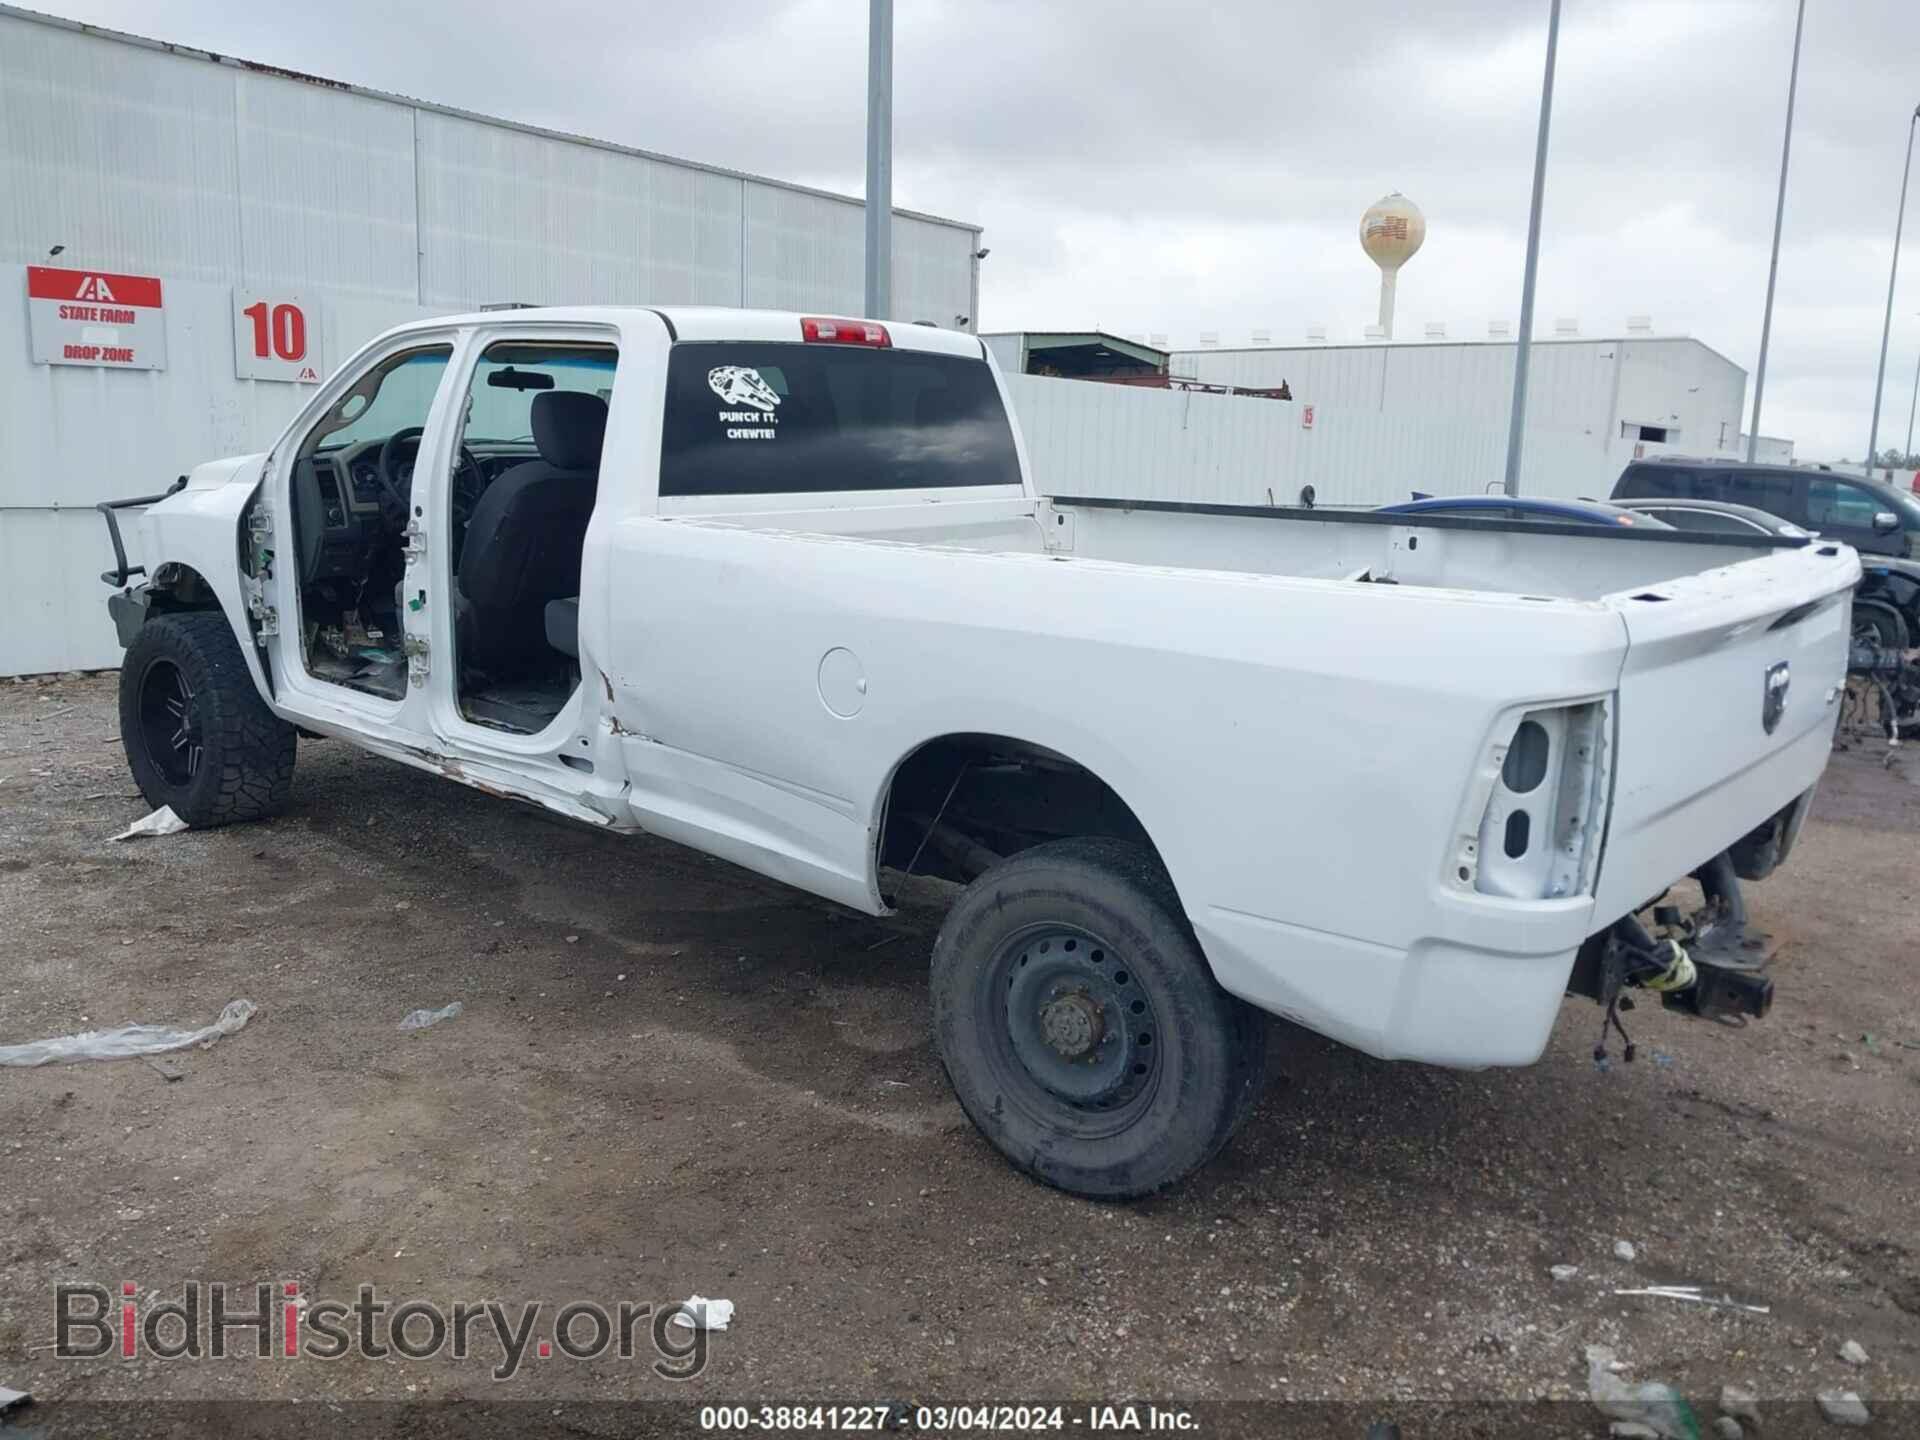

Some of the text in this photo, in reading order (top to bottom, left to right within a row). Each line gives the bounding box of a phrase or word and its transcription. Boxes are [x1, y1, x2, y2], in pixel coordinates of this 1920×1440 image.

[59, 304, 136, 325] STATE FARM
[243, 302, 306, 362] 10
[63, 344, 135, 363] DROP ZONE
[719, 411, 760, 422] PUNCH
